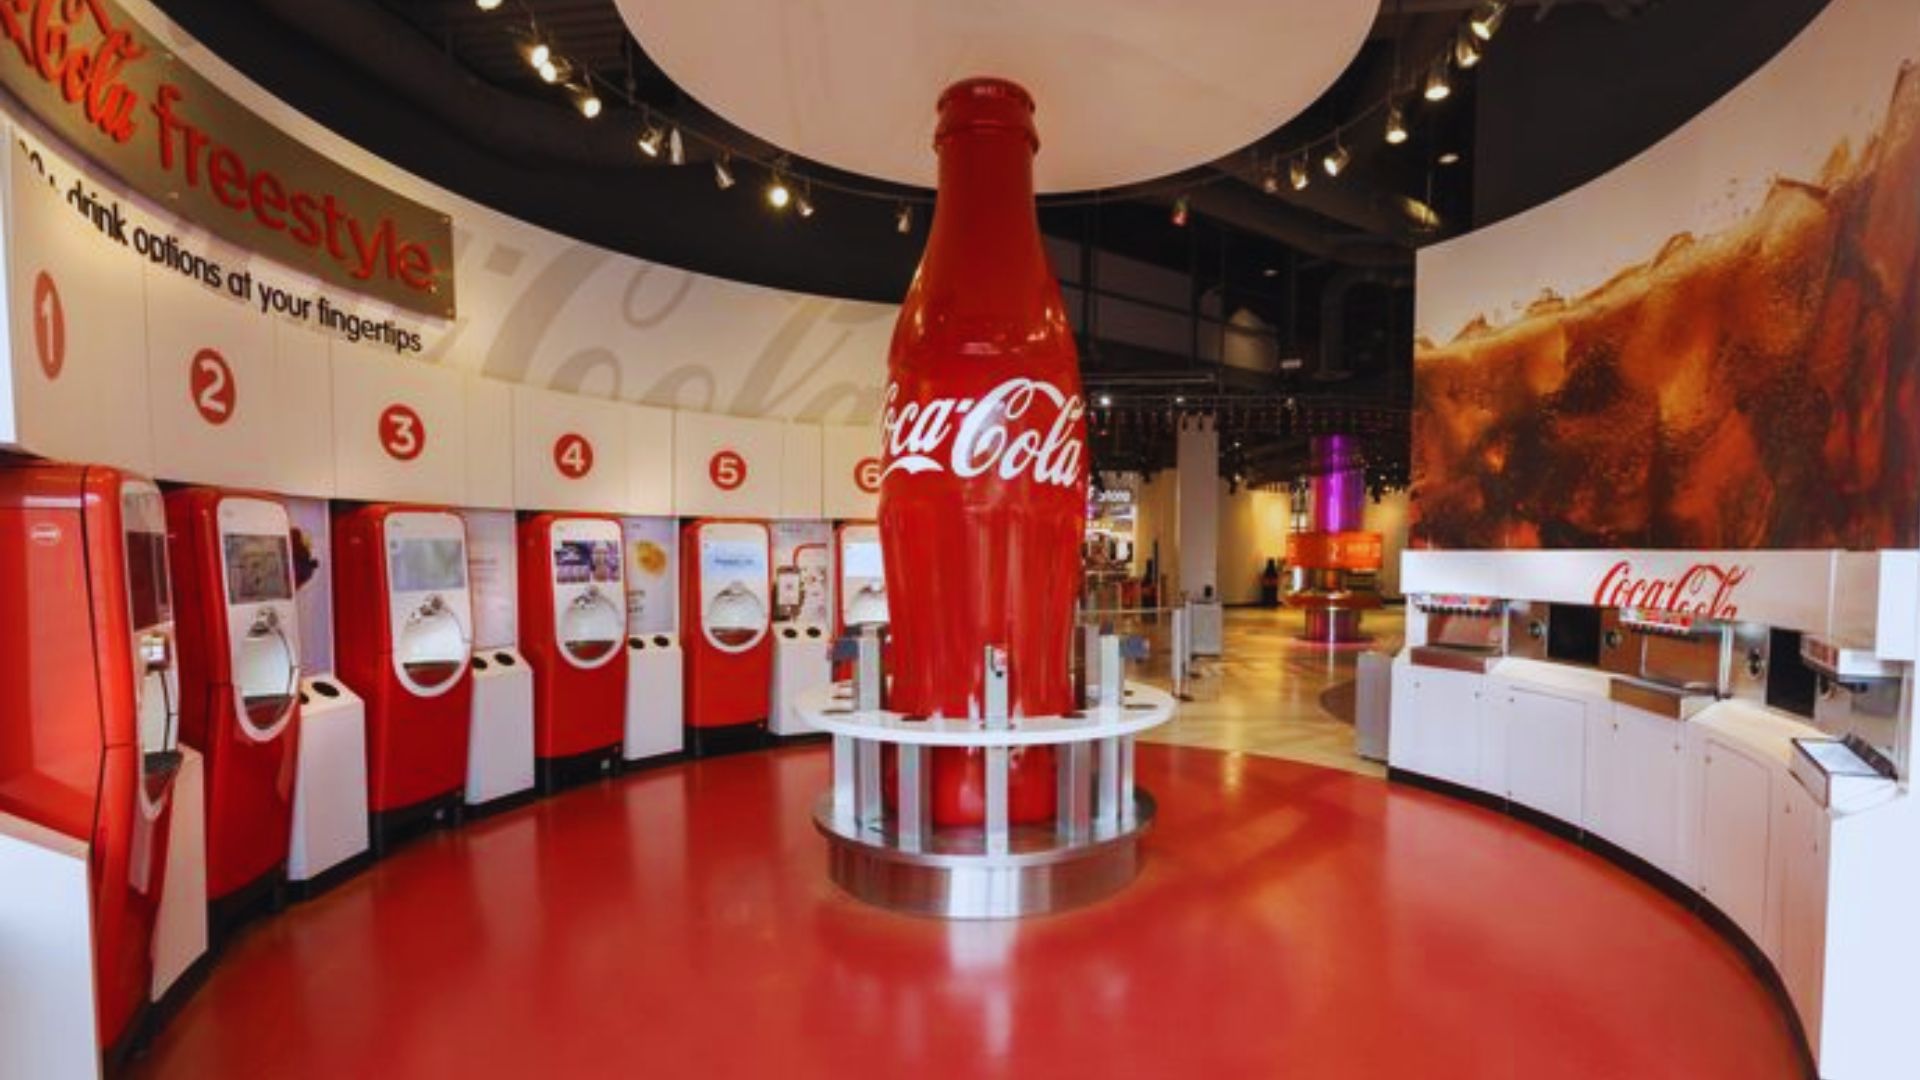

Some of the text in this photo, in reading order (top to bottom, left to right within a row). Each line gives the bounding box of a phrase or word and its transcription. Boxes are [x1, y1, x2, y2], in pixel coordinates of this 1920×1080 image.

[151, 84, 434, 291] freestyle
[66, 179, 422, 352] drink options at your fingertips
[200, 358, 226, 413] 2
[389, 412, 416, 454] 3
[561, 441, 585, 471] 4
[717, 457, 738, 485] 5
[1594, 560, 1754, 619] Coca-Cola
